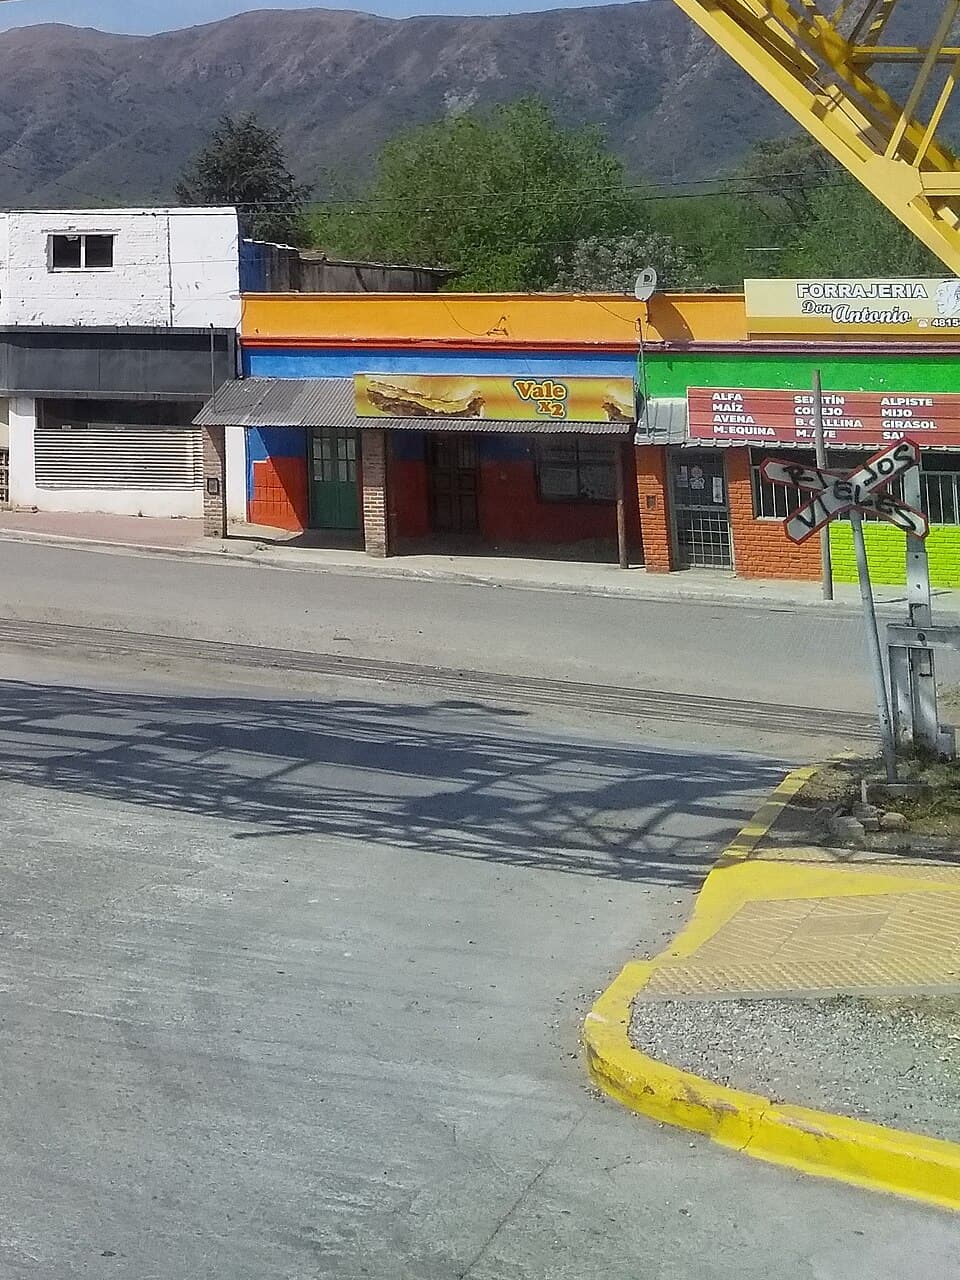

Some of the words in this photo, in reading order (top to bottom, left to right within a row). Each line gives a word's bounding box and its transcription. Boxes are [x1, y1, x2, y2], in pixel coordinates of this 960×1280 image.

[797, 283, 928, 298] FORRAJERIA
[802, 300, 832, 314] Don
[831, 304, 912, 324] Antonio
[930, 318, 960, 327] 4815
[513, 379, 567, 400] Vale
[712, 392, 743, 401] ALFA
[881, 397, 933, 406] ALPISTE
[712, 402, 744, 412] MAÍZ
[881, 408, 913, 417] MIJO
[713, 414, 755, 424] AVENA
[882, 420, 938, 429] GIRASOL
